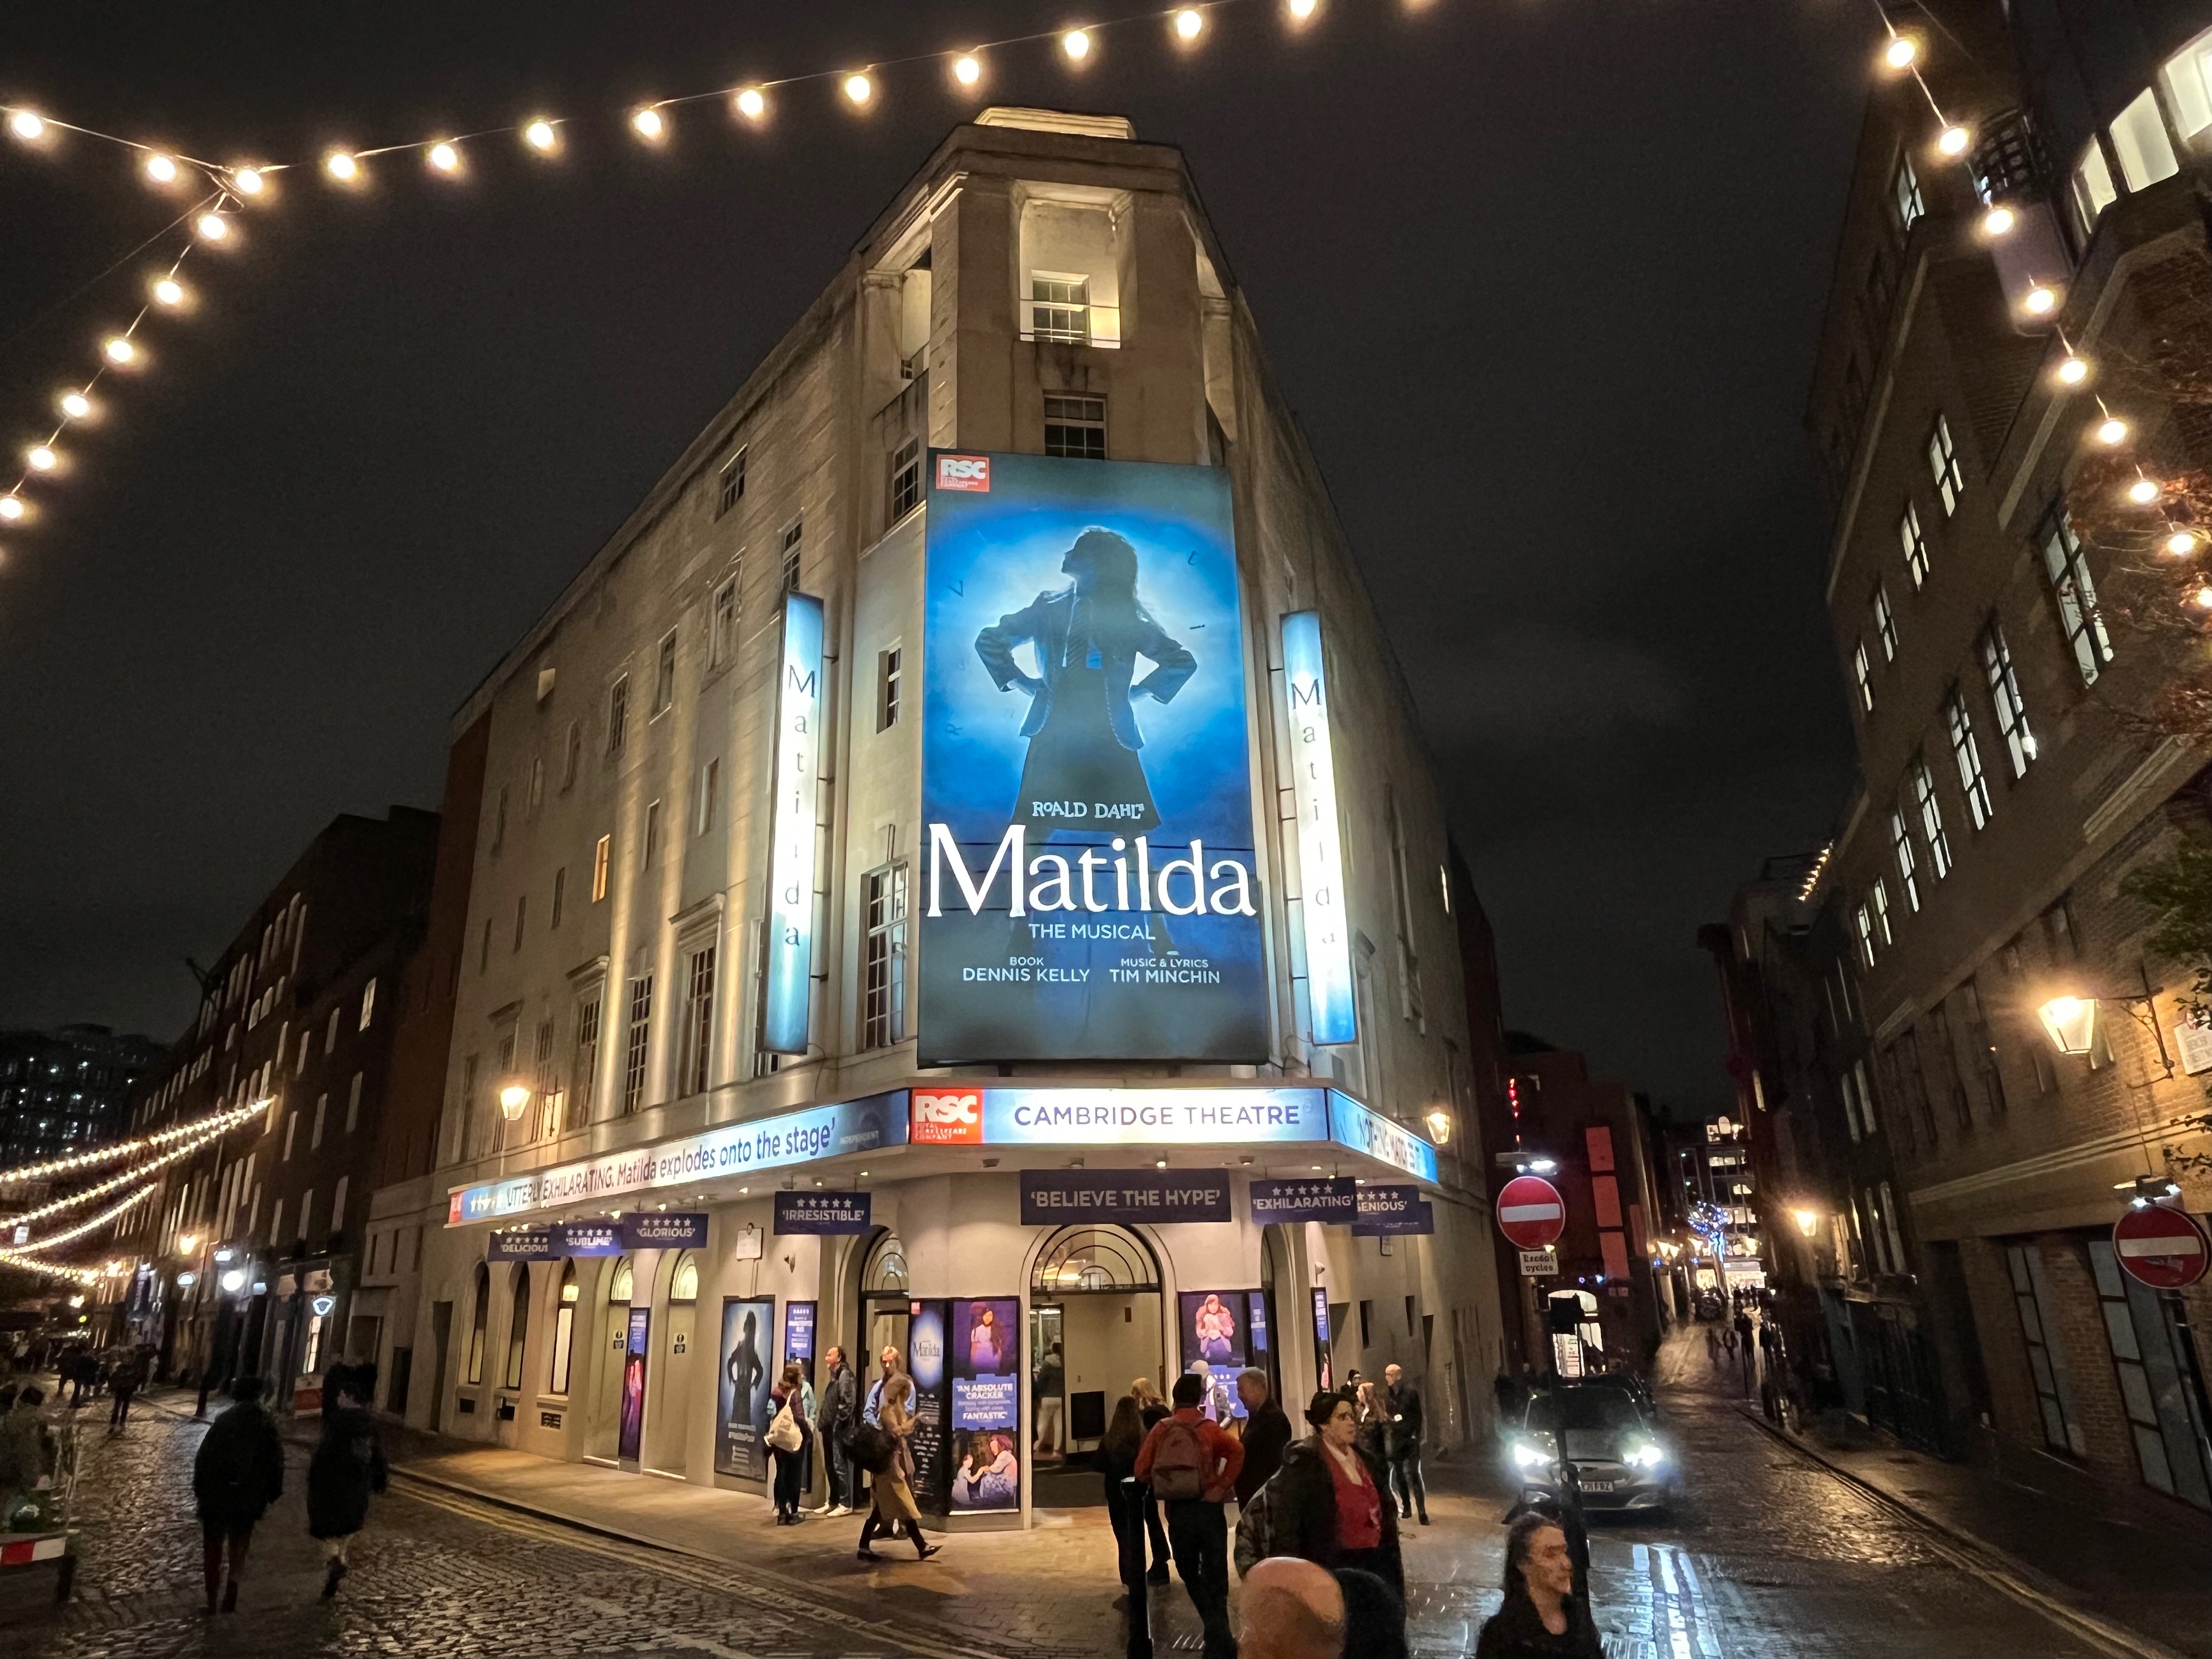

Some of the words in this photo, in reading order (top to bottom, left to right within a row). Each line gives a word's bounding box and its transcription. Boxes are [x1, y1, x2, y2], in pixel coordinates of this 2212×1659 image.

[940, 459, 986, 479] RSC
[785, 664, 816, 946] Matilda
[1032, 801, 1087, 817] ROALD
[927, 823, 1258, 917] Matilda
[1029, 923, 1065, 939] THE
[1071, 924, 1156, 940] MUSICAL
[1009, 956, 1044, 966] BOOK
[1121, 958, 1156, 967] MUSIC
[1159, 958, 1166, 967] &
[1170, 958, 1209, 968] LYRICS
[963, 968, 1030, 982] DENNIS
[1037, 968, 1090, 982] KELLY
[1109, 969, 1139, 983] TIM
[1146, 969, 1220, 984] MINCHIN
[915, 1095, 978, 1124] RSC
[1014, 1107, 1173, 1126] CAMBRIDGE
[1184, 1105, 1300, 1125] THEATRE
[617, 1156, 657, 1186] Matilda
[660, 1145, 715, 1178] explodes
[720, 1137, 752, 1167] onto
[757, 1131, 781, 1160] the
[1031, 1190, 1118, 1207] 'BELIEVE
[1122, 1190, 1160, 1206] THE
[1166, 1189, 1220, 1206] HYPE'
[1253, 1195, 1353, 1210] 'EXHILARATING'
[782, 1210, 864, 1221] 'IRRESISTIBLE'
[637, 1227, 696, 1238] 'GLORIOUS'
[566, 1237, 613, 1246] 'SUBLIME'
